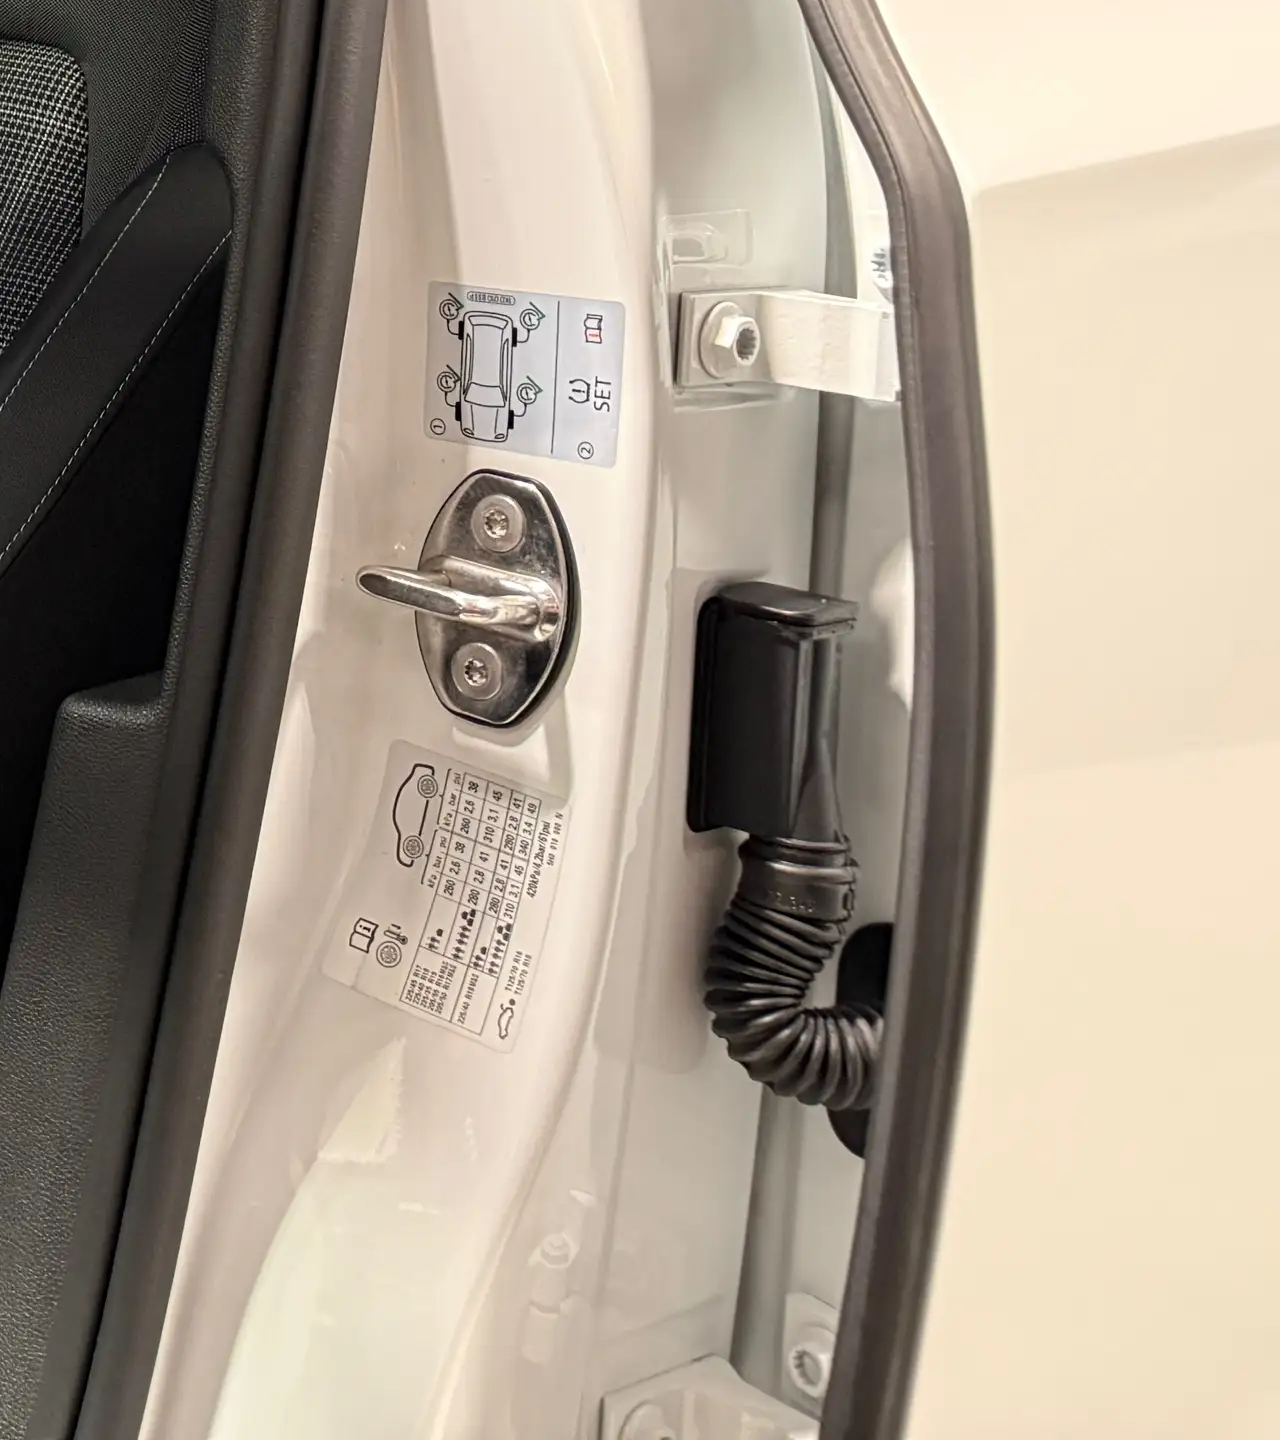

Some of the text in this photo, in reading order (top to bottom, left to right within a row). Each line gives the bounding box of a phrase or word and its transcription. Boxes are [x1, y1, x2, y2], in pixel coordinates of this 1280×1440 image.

[594, 376, 612, 412] SET
[513, 798, 522, 809] 41
[527, 803, 537, 814] 49
[428, 875, 437, 888] kPa
[448, 793, 456, 806] bar
[444, 781, 478, 896] 260 2,6 38 260 2,6 38
[504, 834, 517, 851] 280
[468, 790, 502, 906] 280 2,8 41 310 3,1 45
[518, 840, 529, 856] 340
[500, 860, 509, 870] 41
[514, 864, 524, 876] 45
[488, 897, 500, 914] 280
[504, 903, 515, 919] 310
